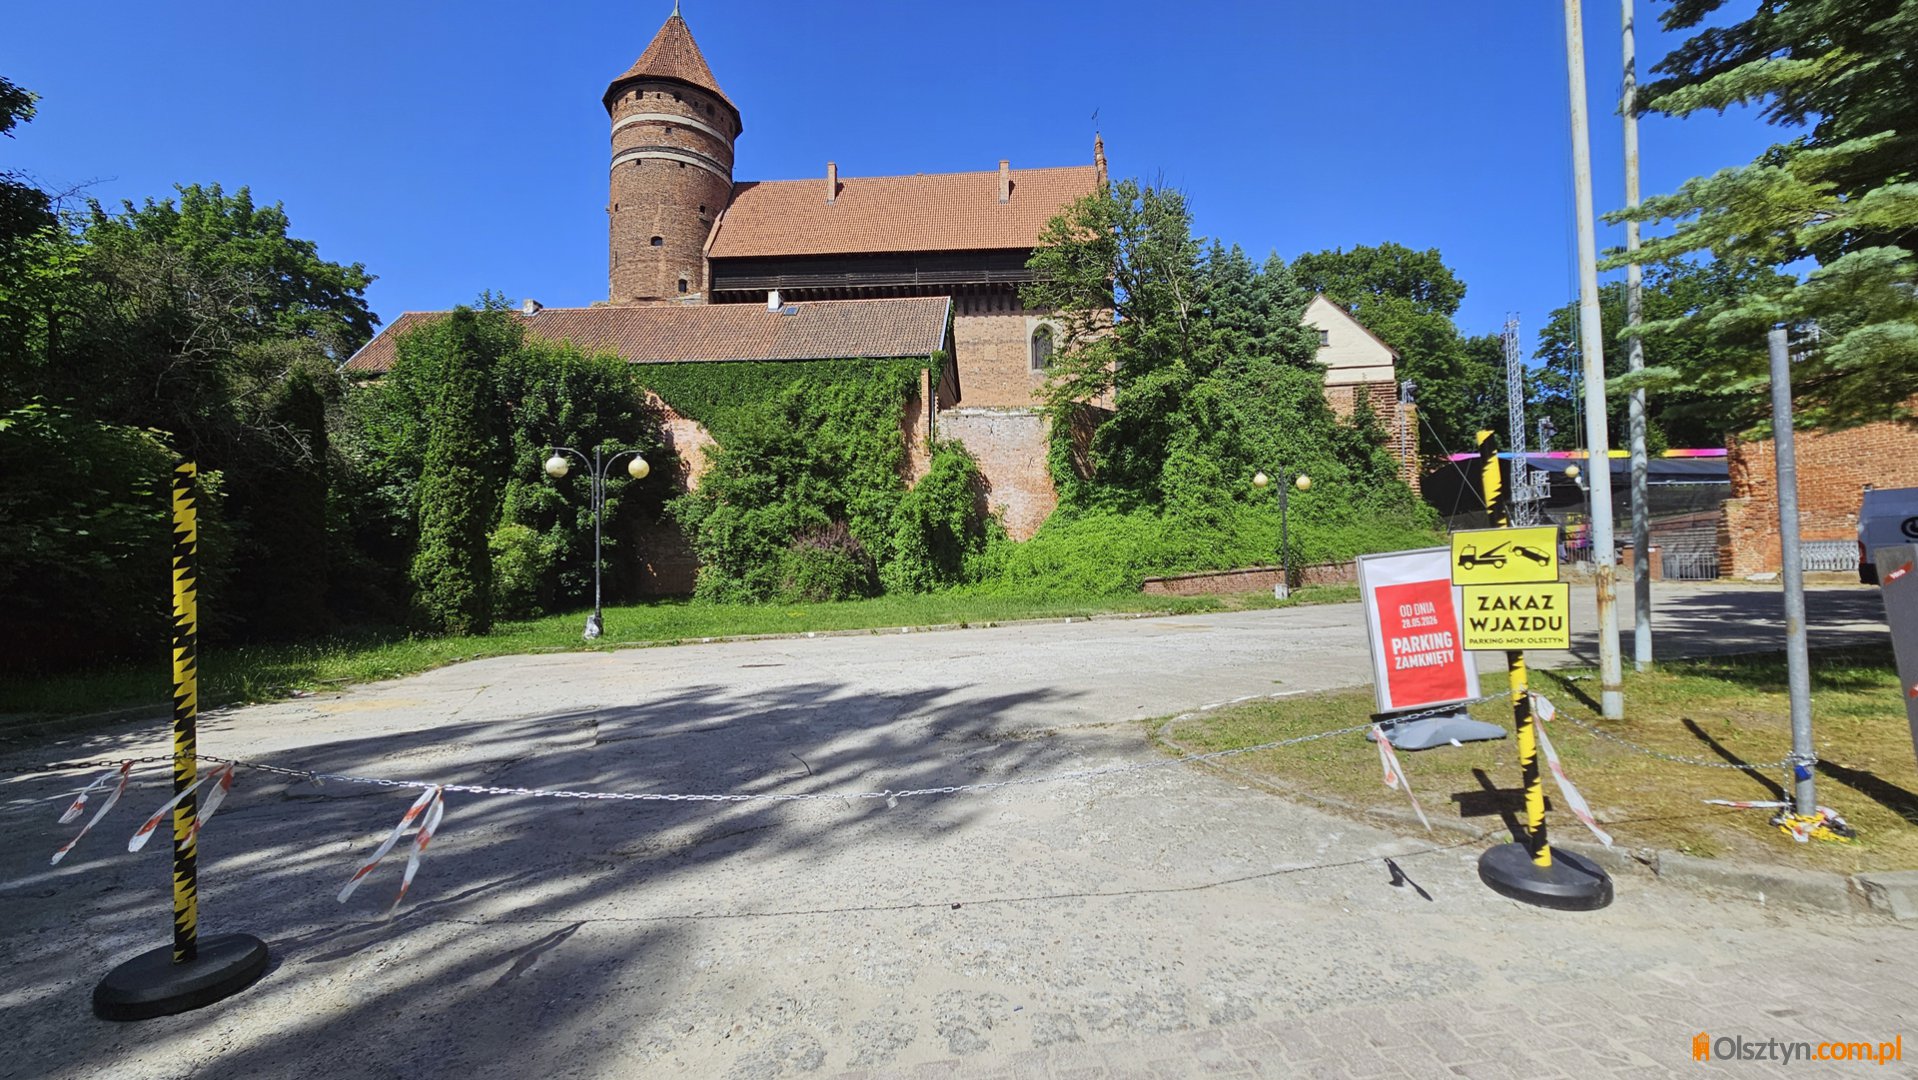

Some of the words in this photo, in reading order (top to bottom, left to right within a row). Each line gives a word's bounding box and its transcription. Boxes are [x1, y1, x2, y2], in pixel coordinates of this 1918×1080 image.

[1399, 604, 1413, 617] OD
[1414, 602, 1435, 615] DNIA
[1477, 595, 1554, 611] ZAKAZ
[1469, 616, 1562, 632] WJAZDU
[1392, 632, 1453, 655] PARKING
[1395, 650, 1454, 670] ZAMKNIĘTY
